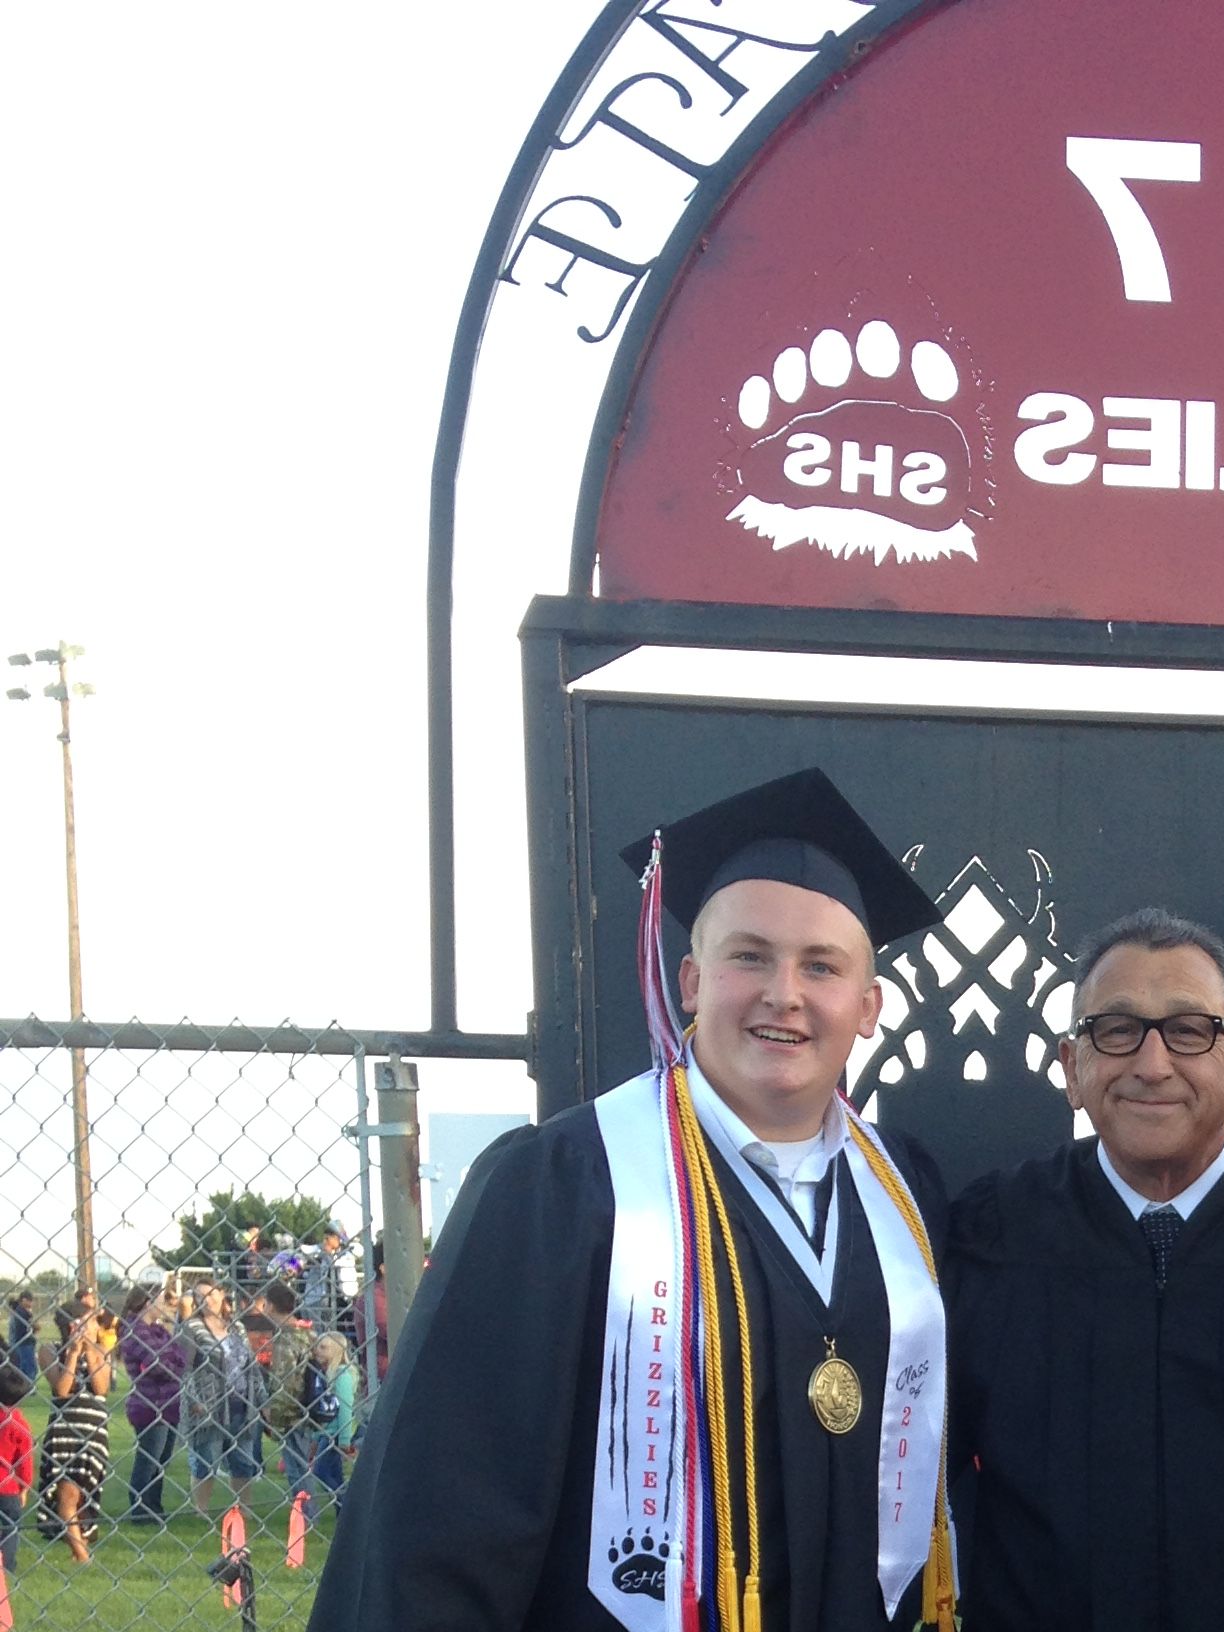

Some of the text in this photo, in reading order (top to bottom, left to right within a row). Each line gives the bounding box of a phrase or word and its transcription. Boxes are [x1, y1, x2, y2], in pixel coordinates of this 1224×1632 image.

[643, 1280, 668, 1516] GRIZZLIES
[895, 1359, 930, 1392] Class
[908, 1380, 925, 1400] of
[894, 1405, 912, 1523] 2017
